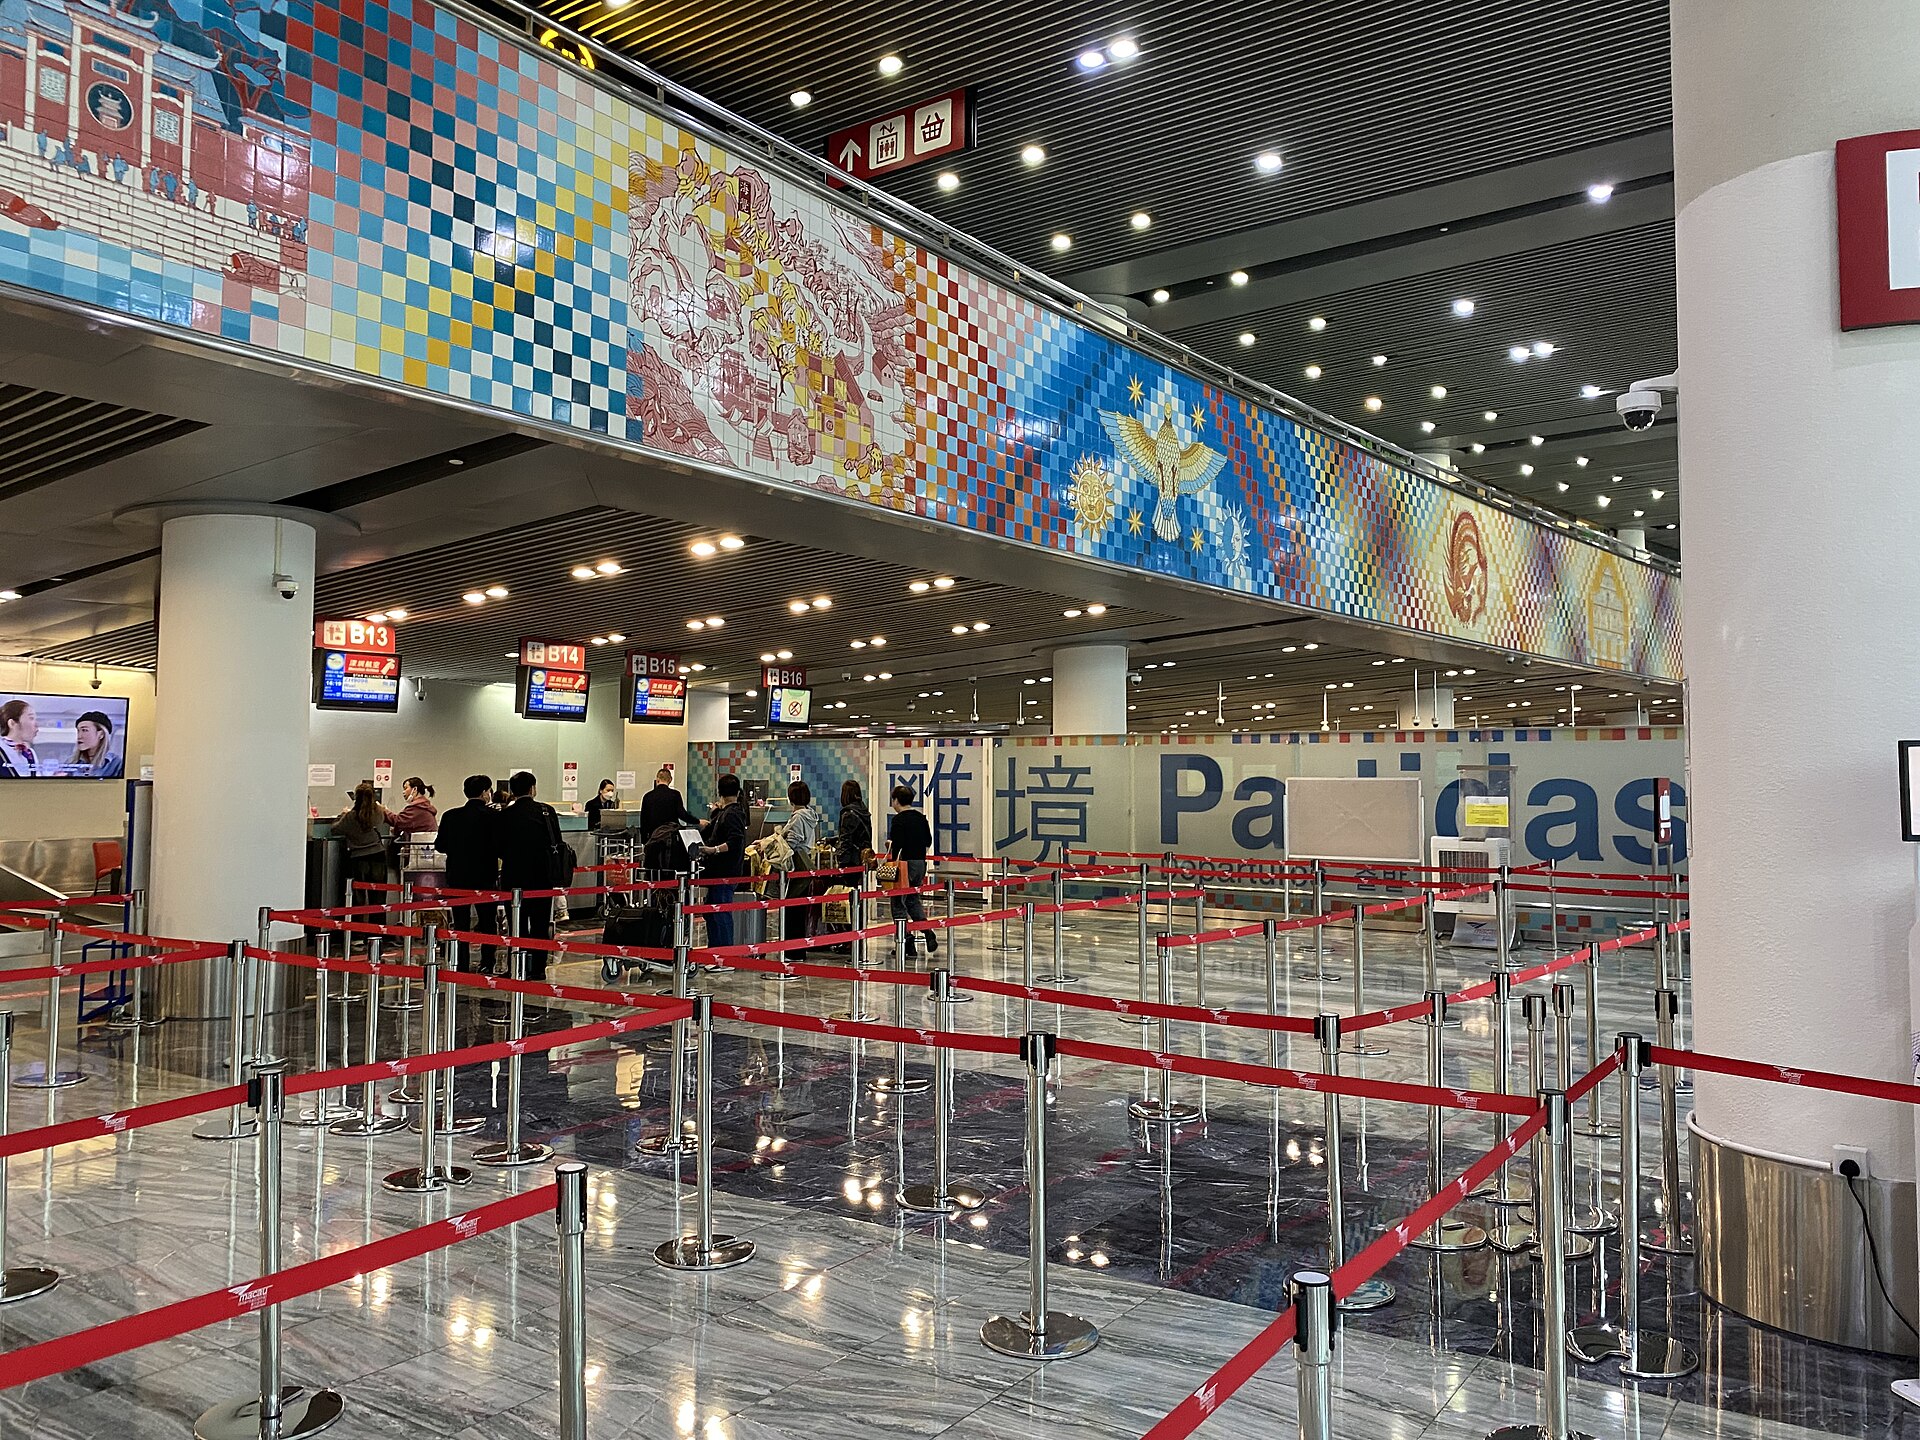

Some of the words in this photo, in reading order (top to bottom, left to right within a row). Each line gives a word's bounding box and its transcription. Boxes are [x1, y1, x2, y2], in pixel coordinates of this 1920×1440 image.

[350, 623, 388, 647] B13
[548, 645, 579, 665] B14
[649, 657, 675, 675] B15
[781, 670, 803, 686] B16
[885, 753, 1096, 873] 離境
[1160, 753, 1689, 865] Padas
